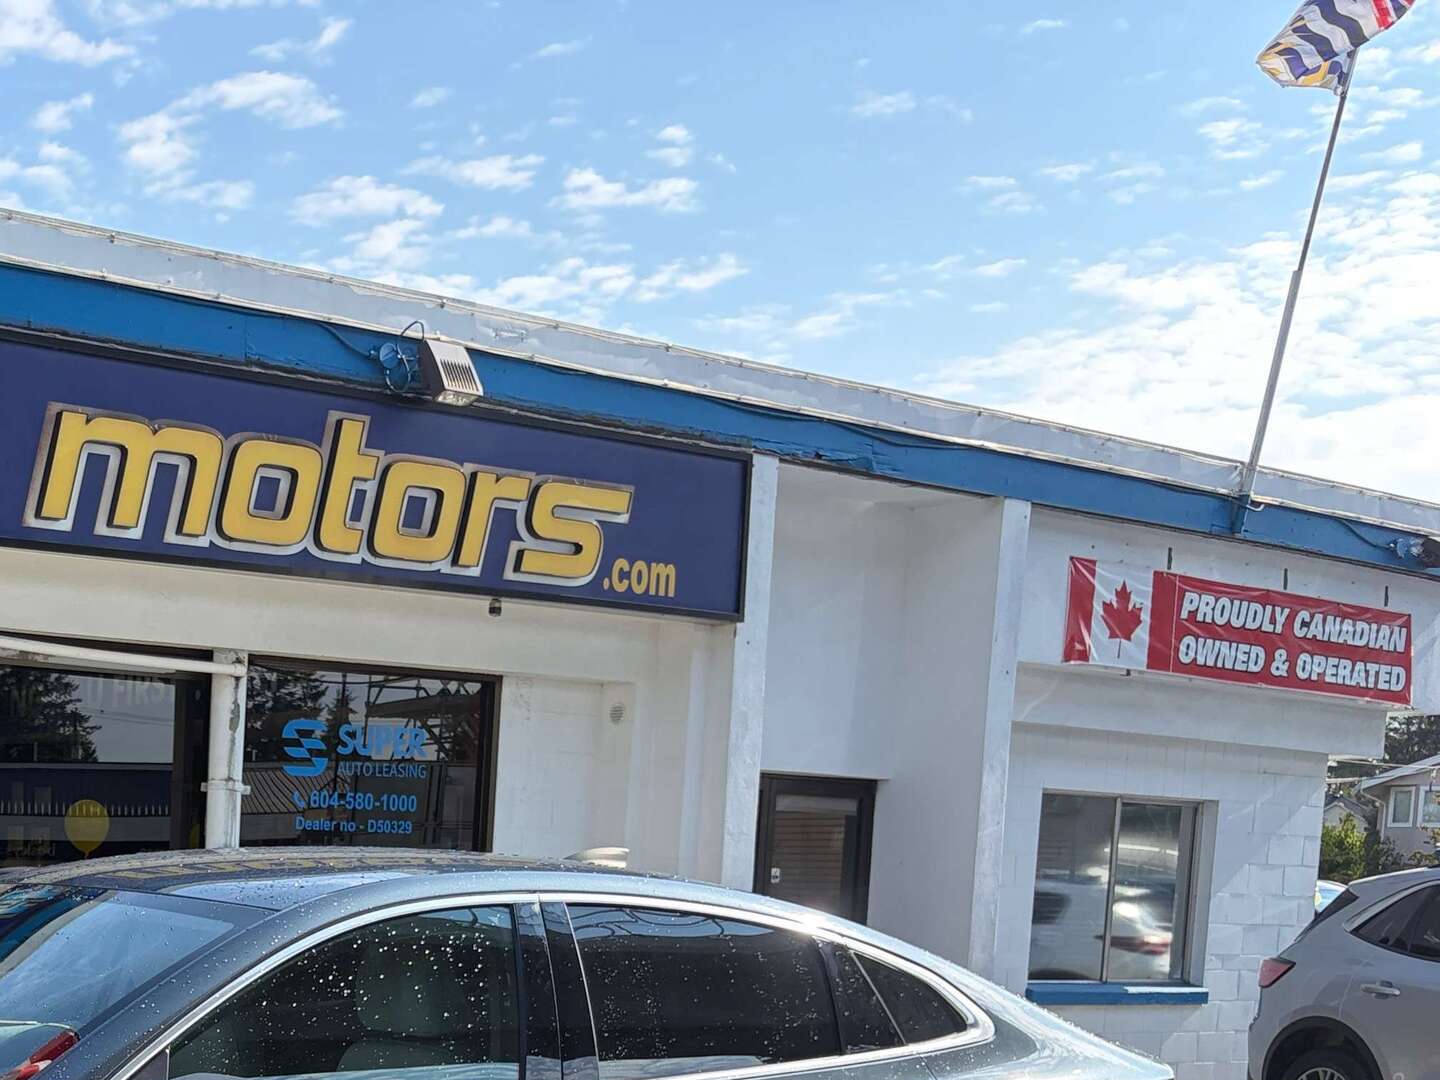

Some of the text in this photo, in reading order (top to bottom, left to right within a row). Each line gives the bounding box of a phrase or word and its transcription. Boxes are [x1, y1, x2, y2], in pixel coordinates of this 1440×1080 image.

[24, 402, 635, 587] motors
[603, 556, 676, 599] .com
[1180, 592, 1407, 653] PROUDLY CANADIAN
[1178, 636, 1406, 692] OWNED & OPERATED
[336, 724, 429, 759] SUPER
[337, 761, 427, 779] AUTO LEASING
[310, 792, 417, 812] 604-580-1000
[295, 817, 337, 832] Dealer
[340, 820, 356, 832] no
[367, 819, 413, 834] D50329
